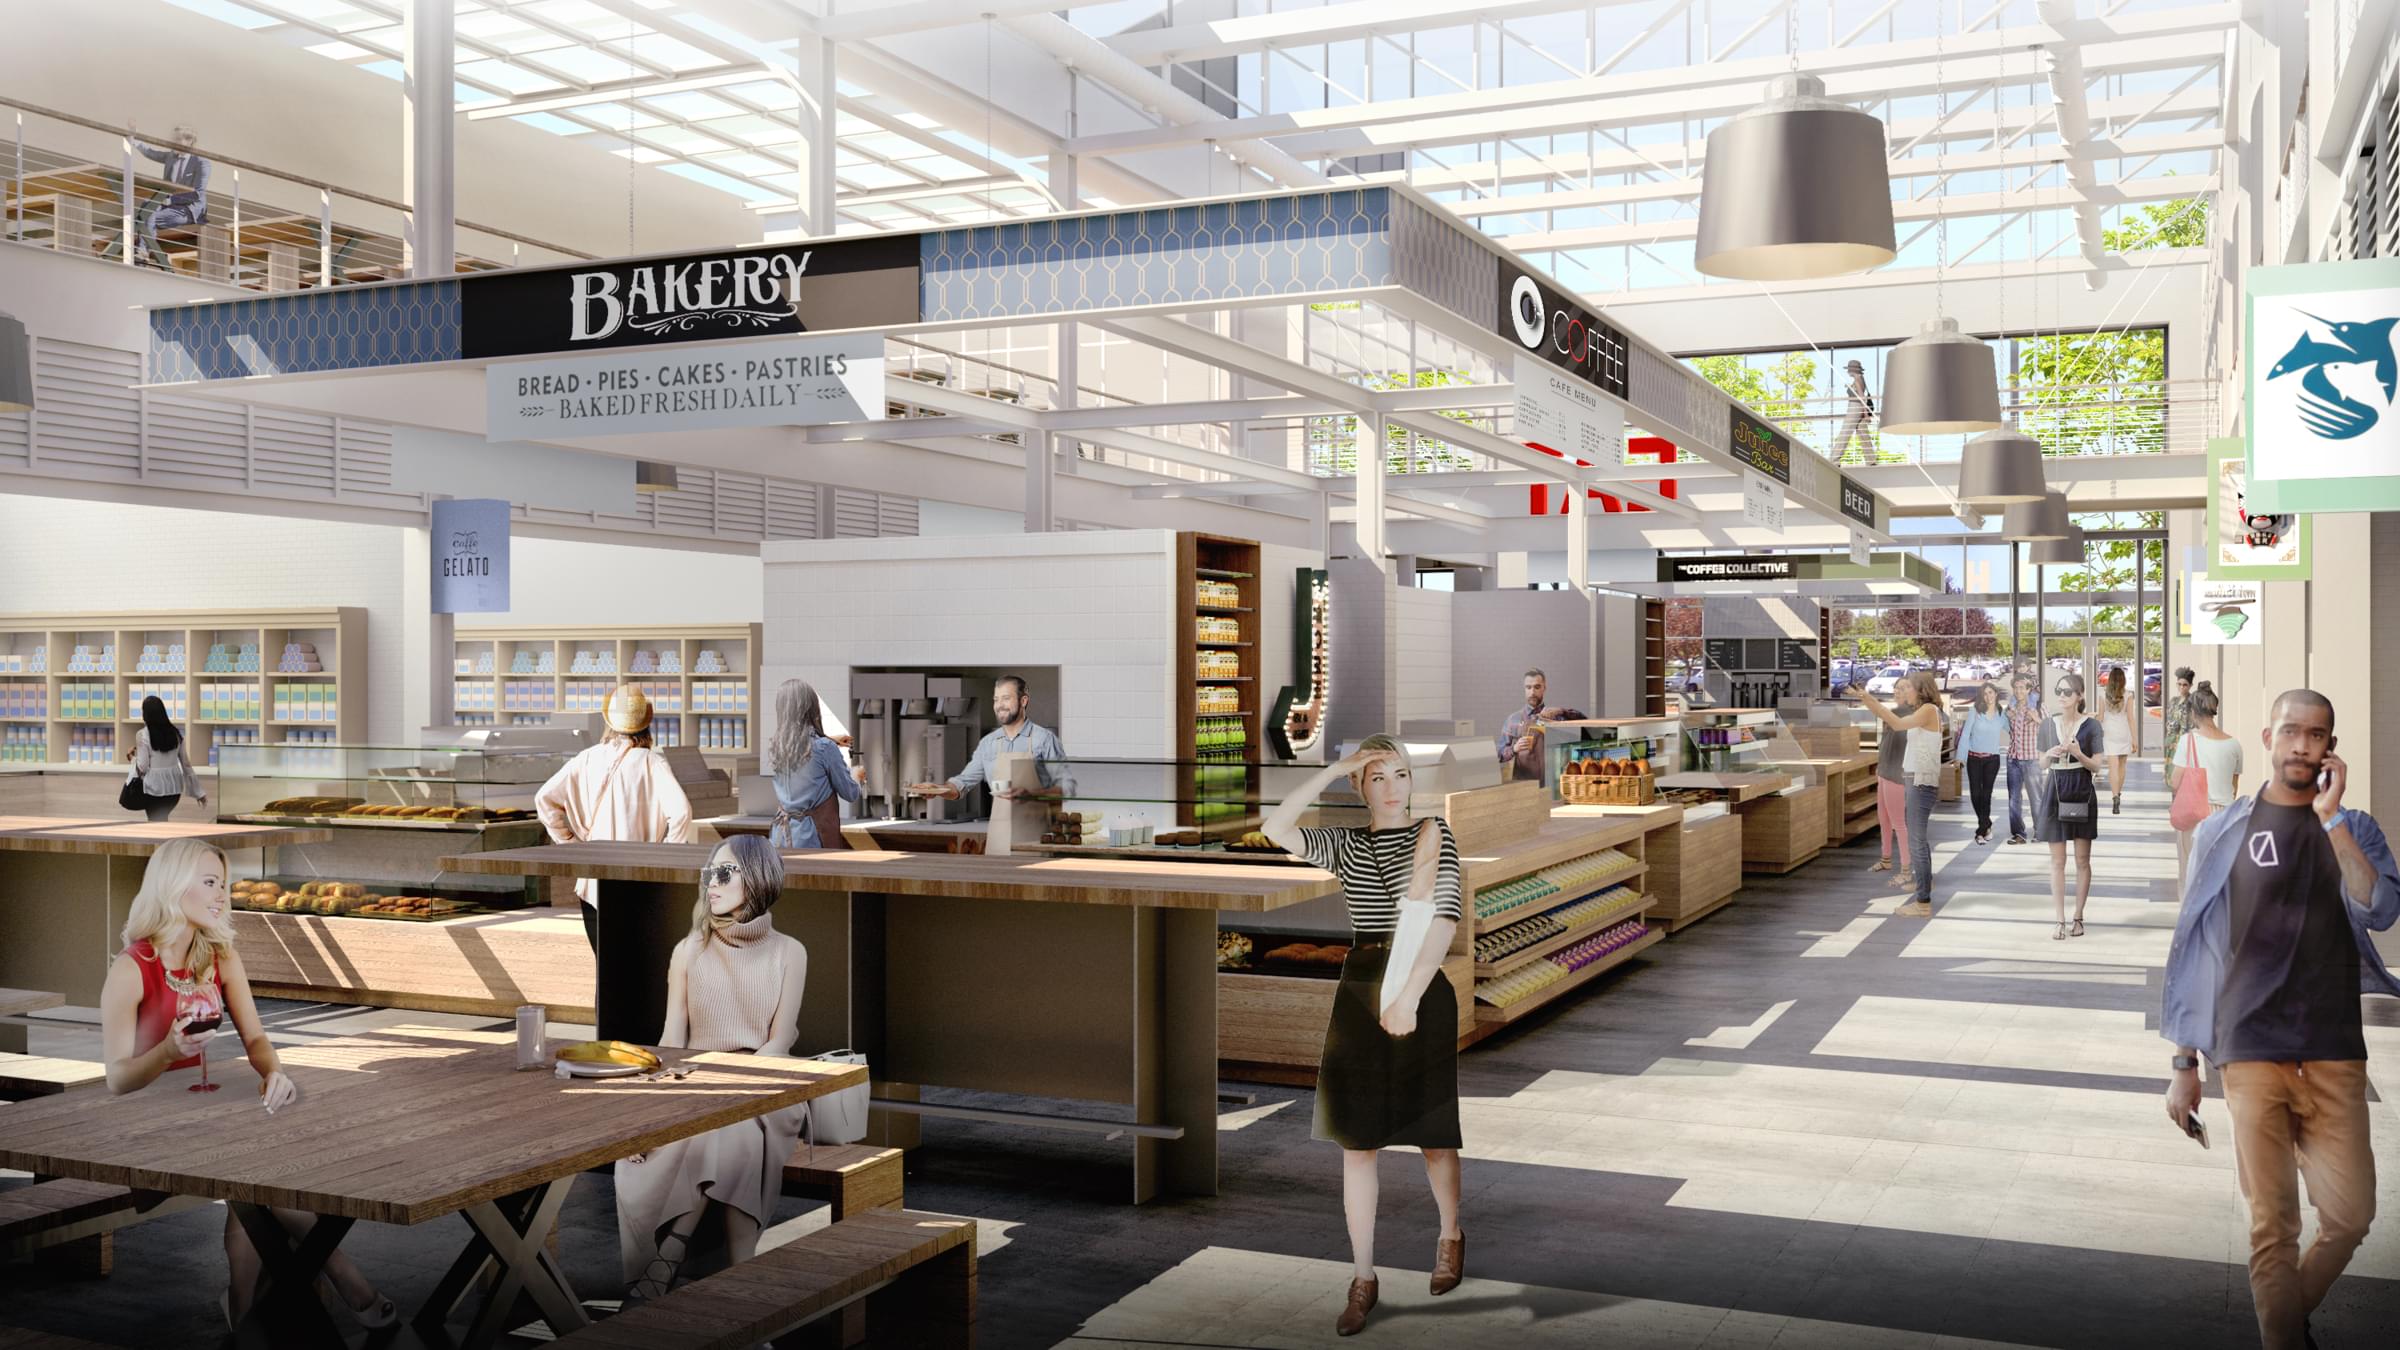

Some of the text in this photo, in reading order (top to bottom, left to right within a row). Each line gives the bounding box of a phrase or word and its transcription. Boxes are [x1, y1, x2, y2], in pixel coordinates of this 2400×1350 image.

[569, 250, 813, 341] BAKERY
[1553, 310, 1624, 386] COFFEE
[518, 352, 848, 397] BREAD PIES CAKES PASTRIES
[560, 382, 803, 420] BAKED FRESH DAILY
[1549, 377, 1598, 409] CAFE MENU
[1750, 449, 1775, 474] Bar
[1845, 488, 1871, 518] BEER
[443, 557, 489, 577] GELATO
[1726, 562, 1789, 574] COLLECTIVE
